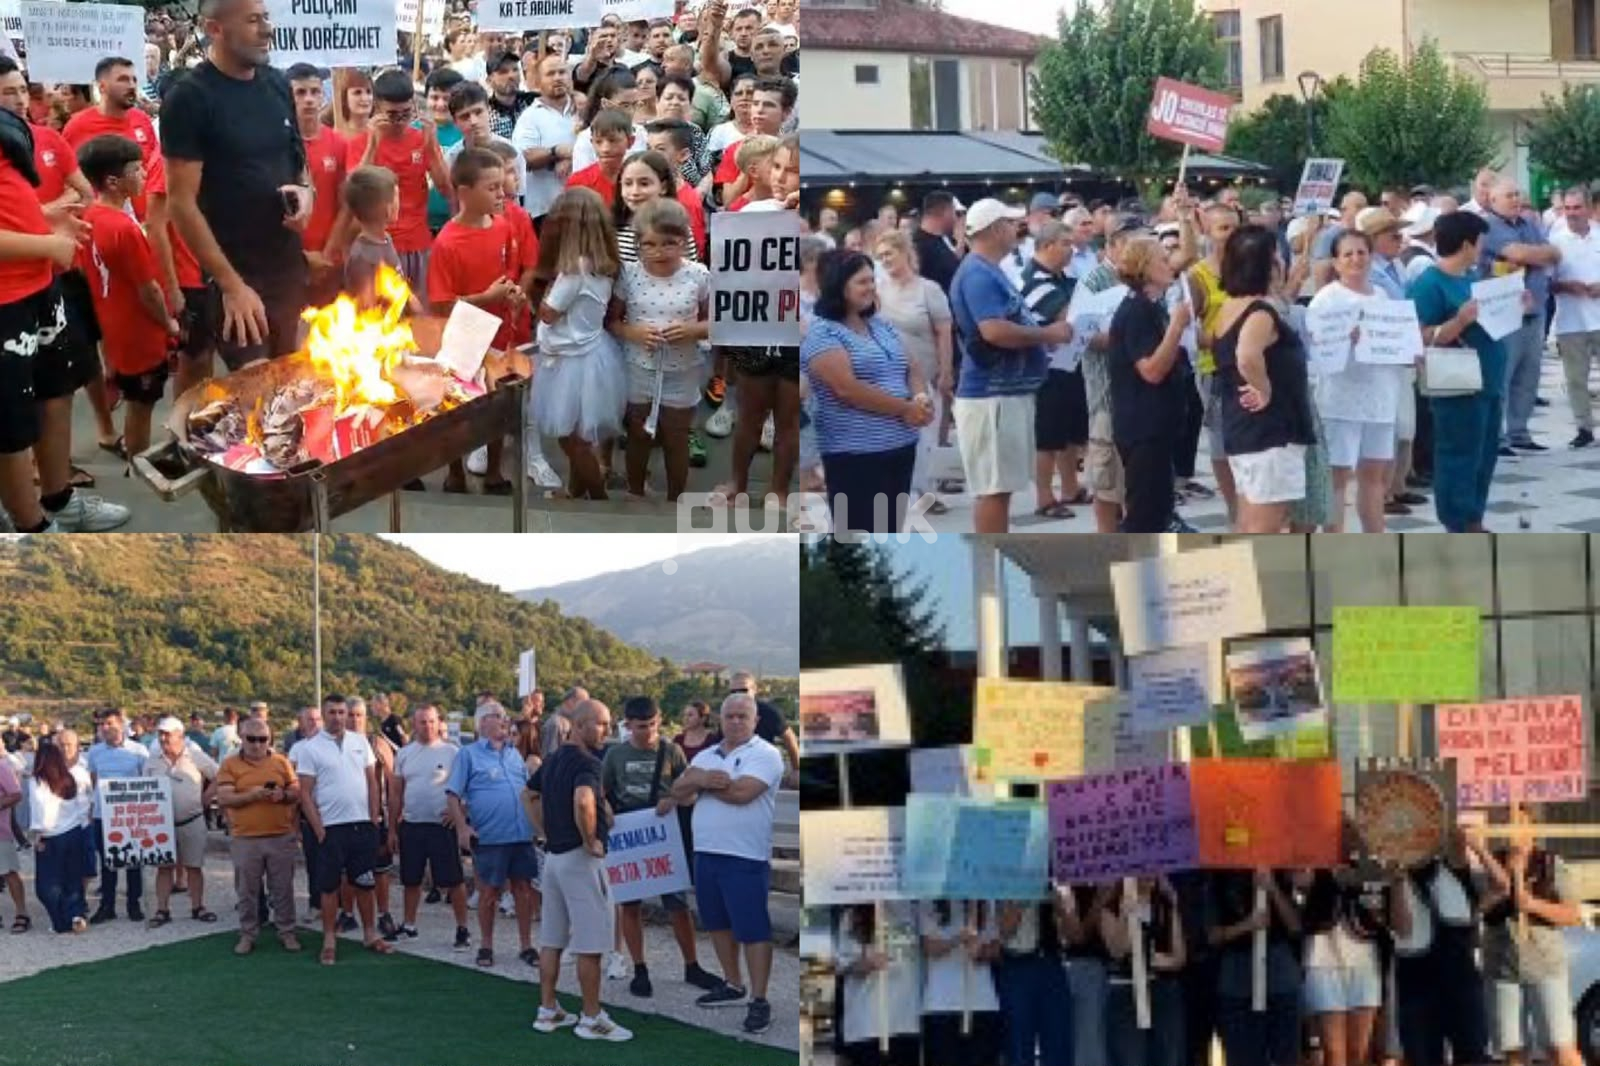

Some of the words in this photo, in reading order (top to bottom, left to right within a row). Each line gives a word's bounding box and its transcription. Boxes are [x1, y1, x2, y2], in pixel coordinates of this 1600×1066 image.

[500, 3, 513, 17] KA
[530, 1, 573, 16] ARDHME
[303, 23, 381, 50] DORËZOHET
[1151, 88, 1178, 124] JO
[718, 238, 751, 272] JO
[714, 290, 769, 322] POR
[778, 289, 800, 322] P
